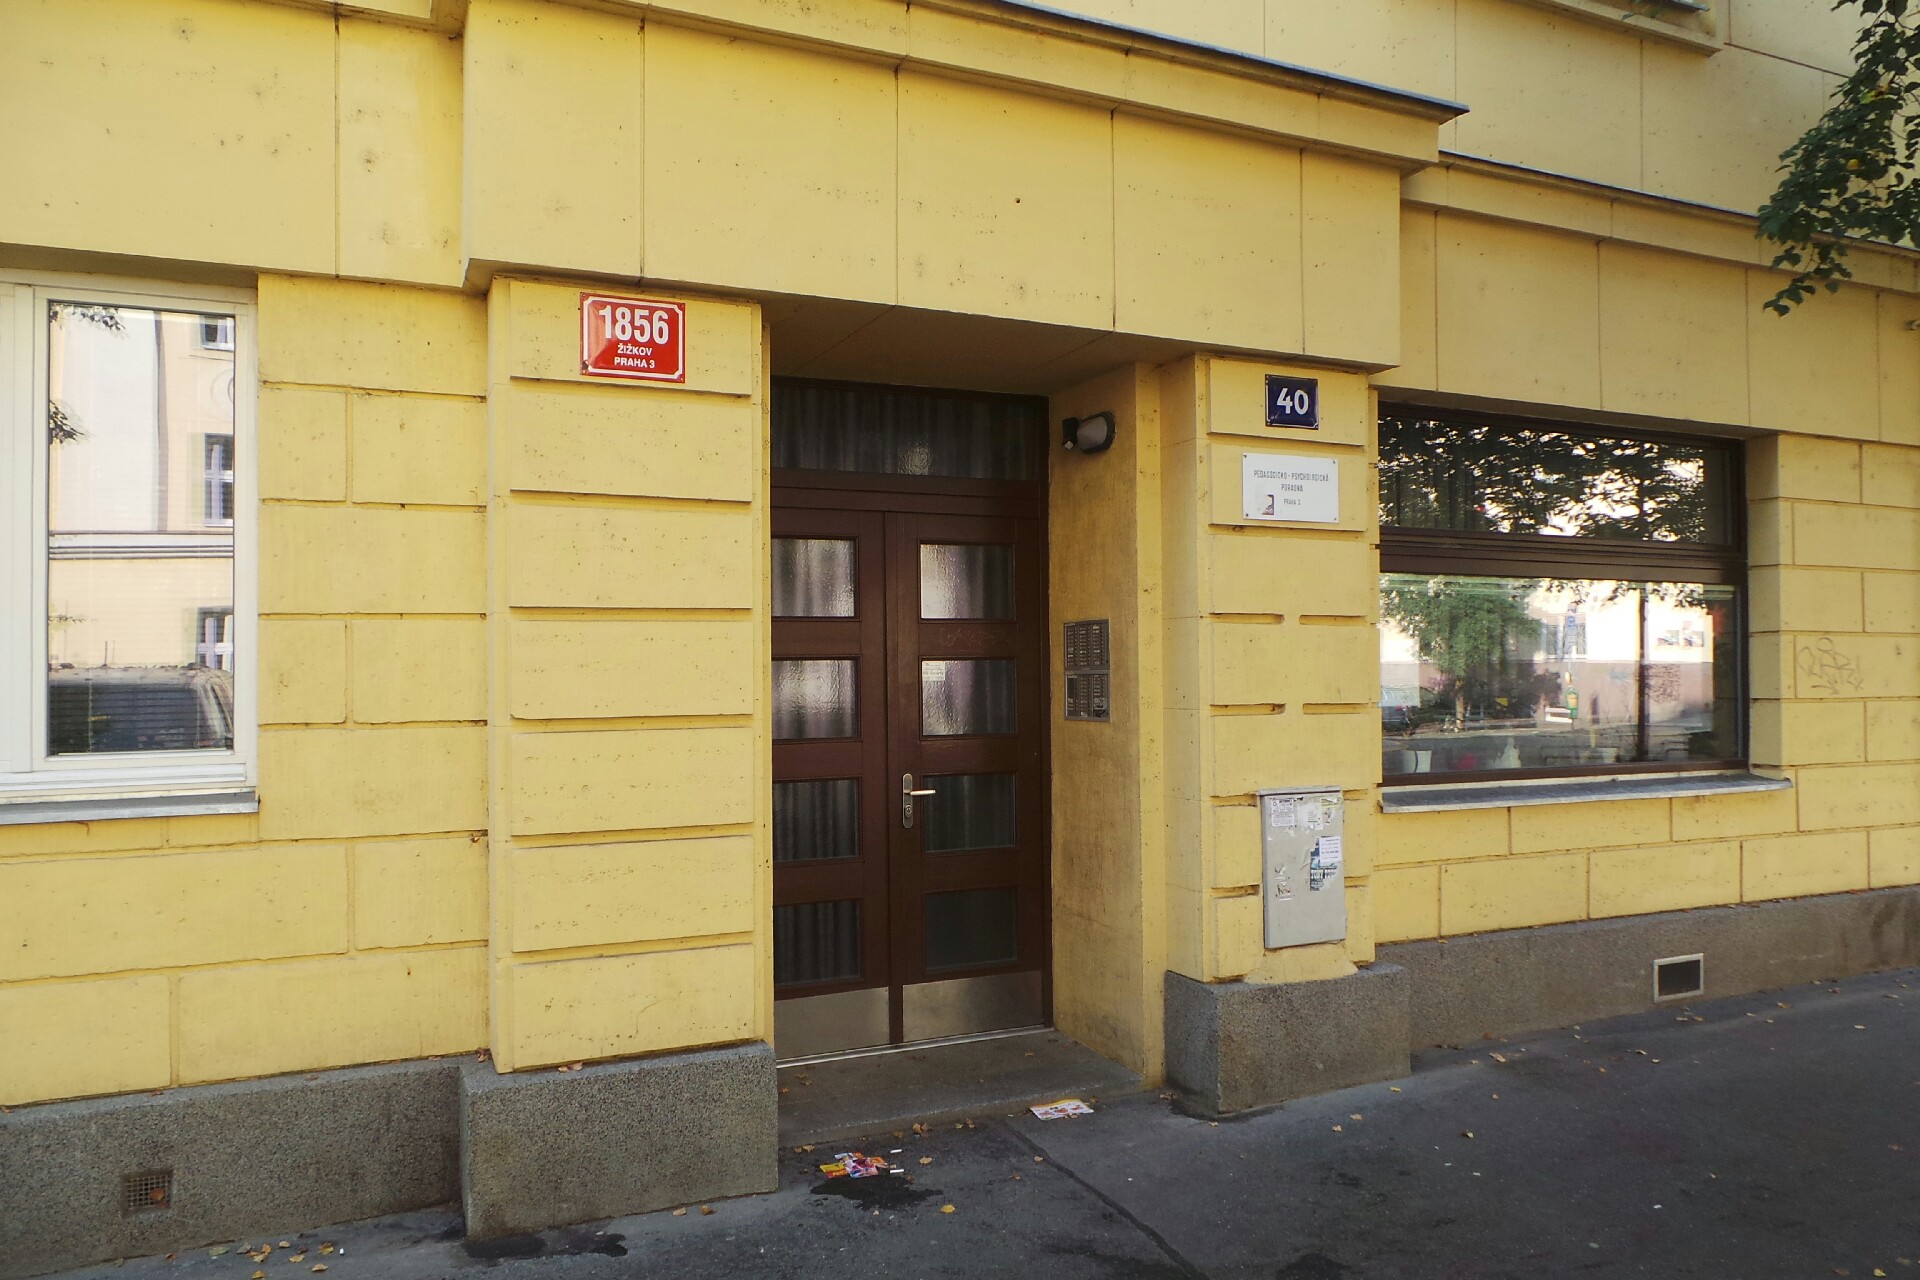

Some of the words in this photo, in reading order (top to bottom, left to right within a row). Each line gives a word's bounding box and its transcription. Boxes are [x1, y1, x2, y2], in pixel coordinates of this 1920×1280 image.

[598, 304, 669, 344] 1856
[617, 342, 653, 356] ŽIŽKOV
[614, 356, 648, 369] PRAHA
[649, 360, 655, 369] 3
[1276, 387, 1309, 416] 40
